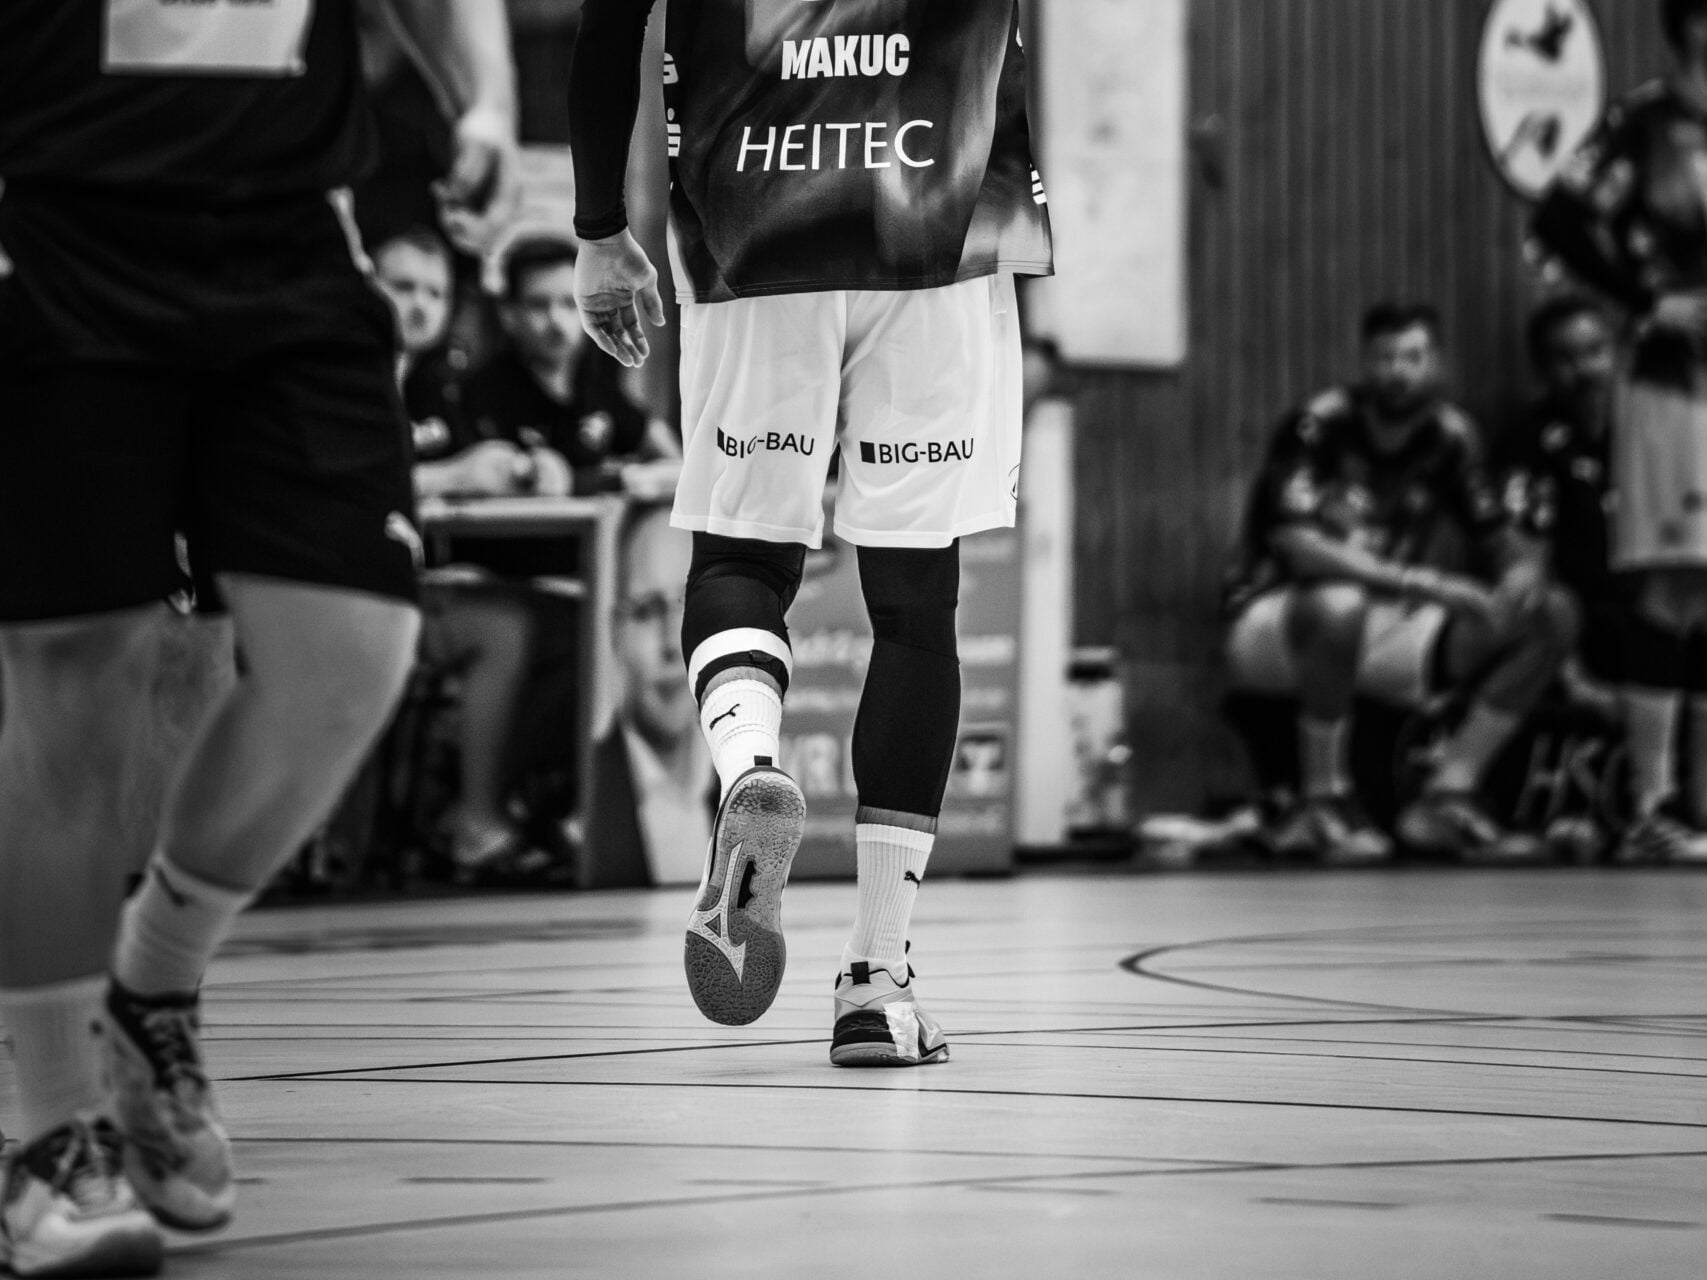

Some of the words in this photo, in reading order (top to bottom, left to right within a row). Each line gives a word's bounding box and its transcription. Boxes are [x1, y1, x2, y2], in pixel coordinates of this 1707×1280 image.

[781, 33, 910, 80] MAKUC
[736, 119, 935, 172] HEITEC
[879, 437, 974, 465] BIG-BAU
